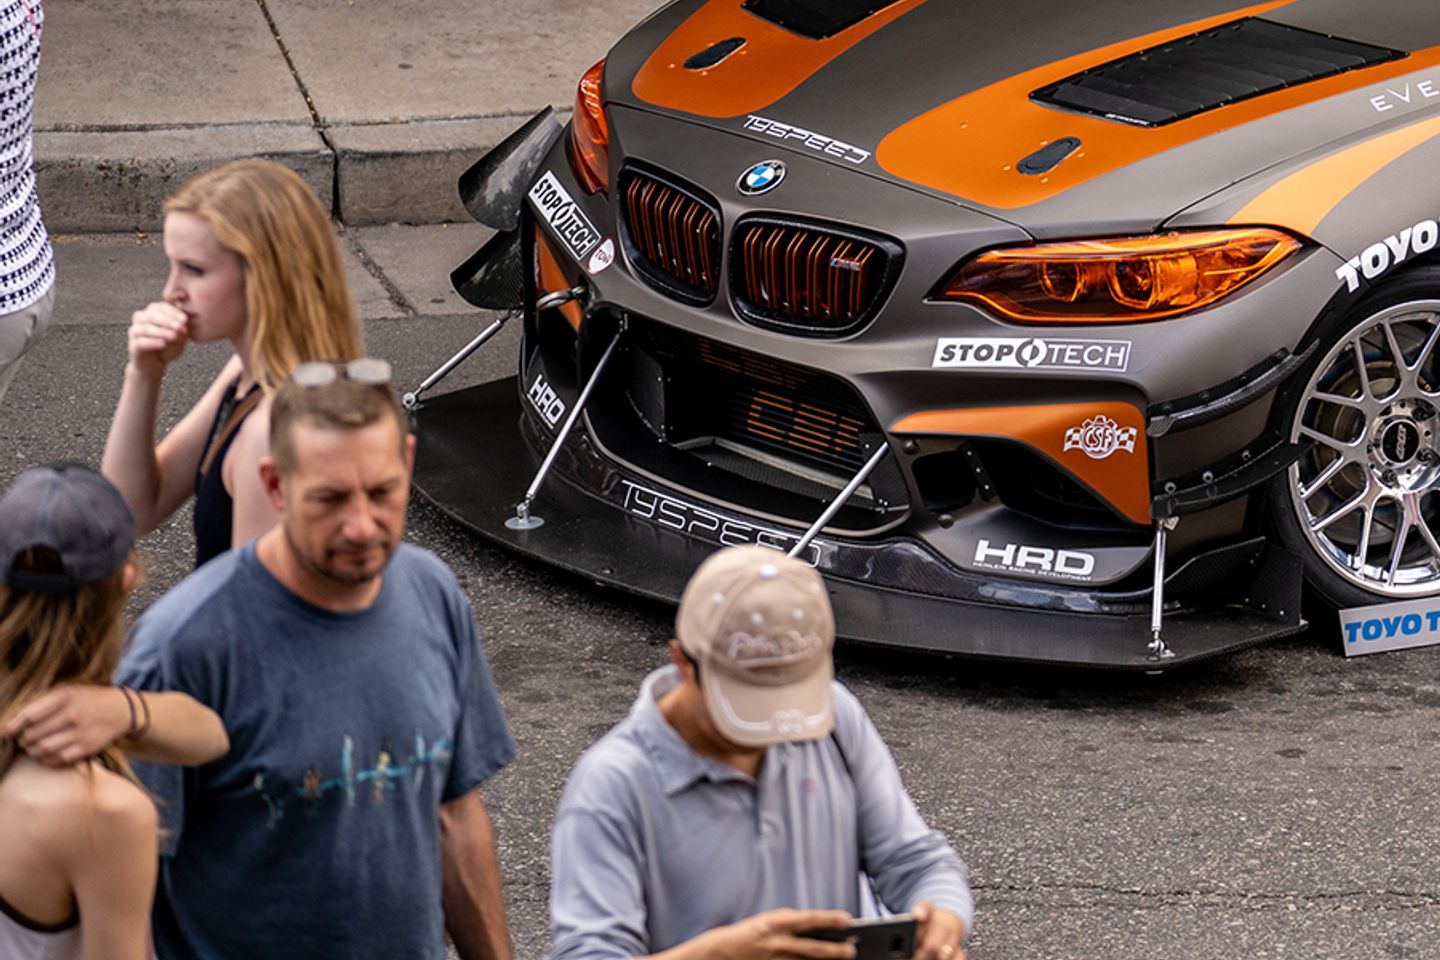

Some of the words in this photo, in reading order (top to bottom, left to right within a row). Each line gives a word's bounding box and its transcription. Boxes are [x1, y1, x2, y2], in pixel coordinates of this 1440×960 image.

[1335, 219, 1438, 293] TOYO
[940, 343, 1015, 362] STOP
[1047, 343, 1126, 367] TECH
[974, 539, 1096, 576] HRD
[1344, 613, 1422, 643] TOYO
